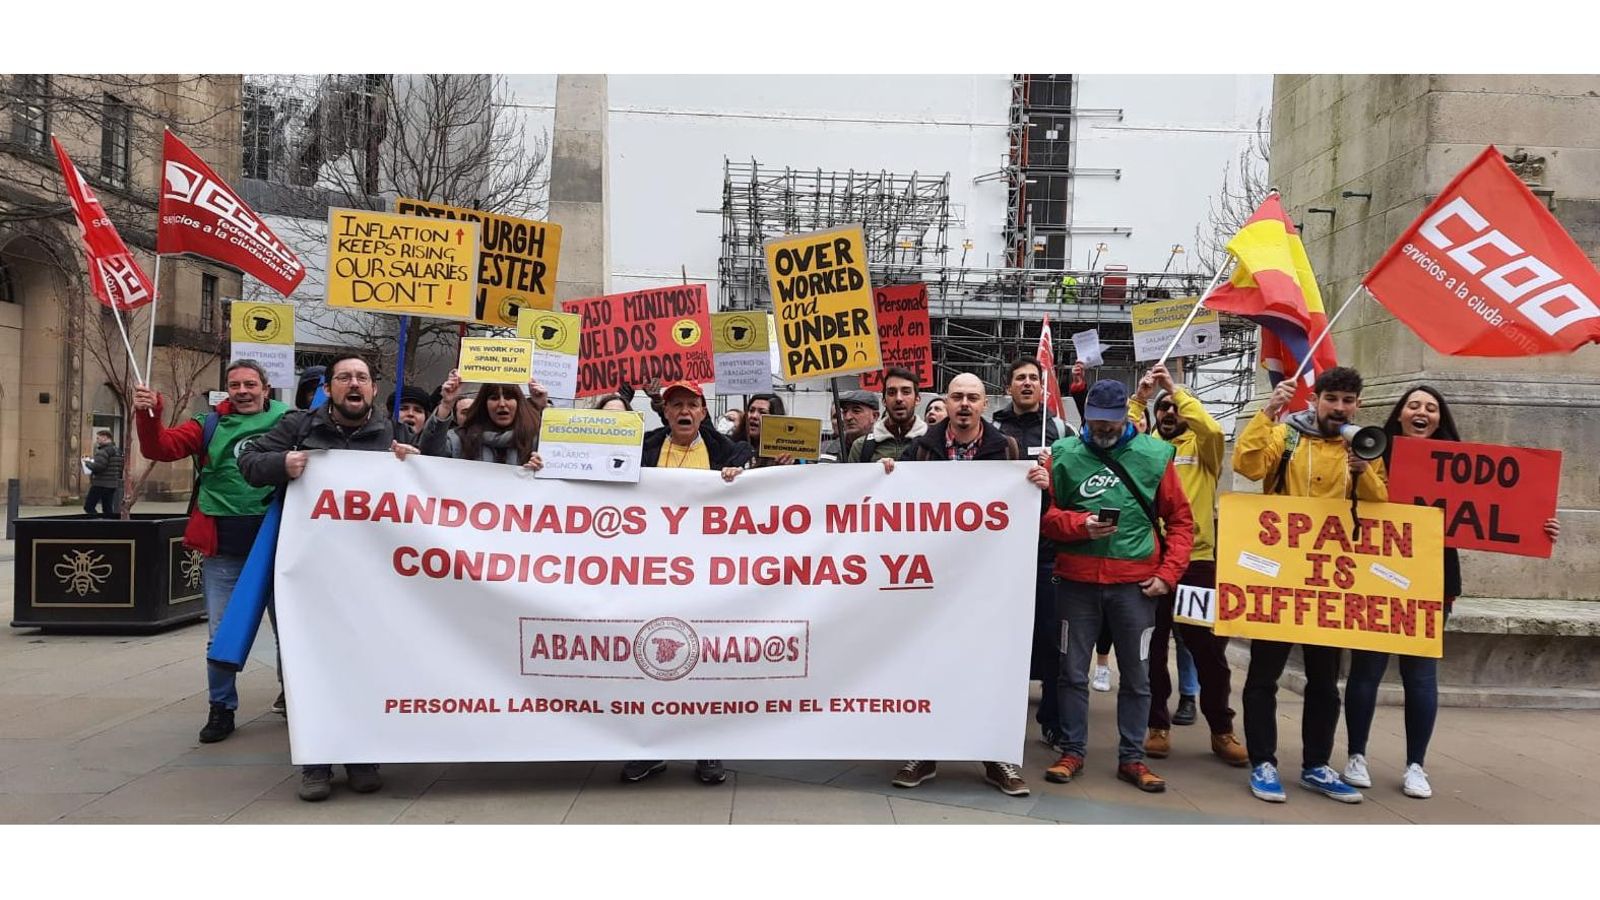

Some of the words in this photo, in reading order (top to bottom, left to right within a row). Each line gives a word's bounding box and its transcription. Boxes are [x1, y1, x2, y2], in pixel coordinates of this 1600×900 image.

[203, 225, 212, 233] a
[215, 228, 227, 239] la
[339, 215, 449, 243] INFLATION
[338, 238, 395, 256] KEEPS
[401, 243, 456, 263] RISING
[775, 237, 854, 276] OVER
[1418, 196, 1600, 336] CCOO
[282, 263, 296, 275] de
[336, 257, 386, 279] OUR
[389, 260, 468, 282] SALARIES
[479, 252, 547, 295] ESTER
[777, 267, 864, 303] WORKED
[1402, 243, 1448, 282] ervicios
[1445, 278, 1458, 289] a
[1454, 282, 1470, 300] la
[352, 280, 440, 304] DON'T
[623, 289, 702, 322] MÍNIMOS!
[782, 296, 819, 320] and
[876, 288, 928, 313] Personal
[579, 322, 658, 360] UELDOS
[783, 308, 871, 349] UNDER
[878, 315, 904, 338] oral
[908, 320, 924, 336] en
[504, 366, 527, 374] SPAIN
[685, 360, 714, 381] 2008
[787, 343, 848, 376] PAID
[548, 425, 636, 437] DESCONSULADOS!
[580, 462, 593, 471] YA
[1430, 451, 1520, 488] TODO
[311, 489, 647, 538] ABANDONAD@S
[660, 506, 689, 535] Y
[702, 504, 812, 535] BAJO
[825, 496, 1010, 534] MÍNIMOS
[1258, 510, 1413, 558] SPAIN
[392, 545, 695, 586] CONDICIONES
[709, 554, 868, 586] DIGNAS
[879, 554, 934, 585] YA
[1304, 552, 1357, 589] IS
[1177, 588, 1210, 619] IN
[1218, 582, 1442, 639] DIFFERENT
[384, 698, 501, 714] PERSONAL
[507, 698, 604, 714] LABORAL
[610, 700, 645, 715] SIN
[651, 700, 759, 715] CONVENIO
[765, 699, 792, 713] EN
[799, 699, 823, 713] EL
[829, 698, 931, 713] EXTERIOR
